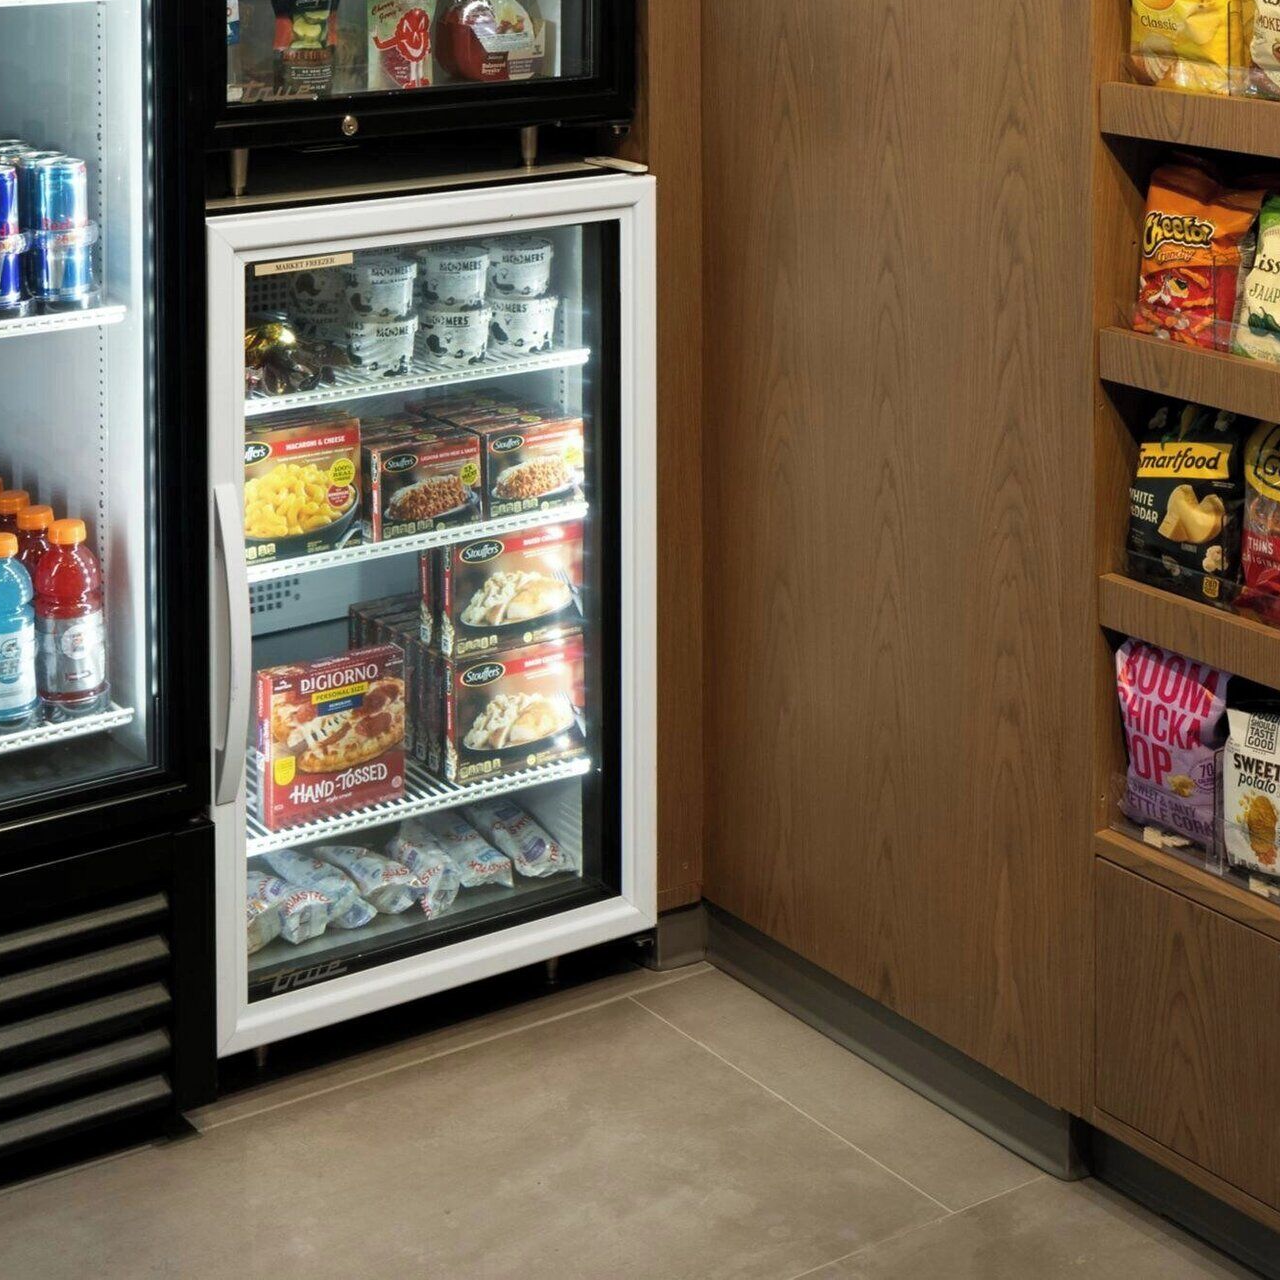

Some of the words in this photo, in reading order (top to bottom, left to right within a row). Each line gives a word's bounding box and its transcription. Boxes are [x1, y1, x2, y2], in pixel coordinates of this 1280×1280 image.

[1140, 15, 1178, 32] Classic
[275, 260, 305, 271] MARKET
[305, 257, 335, 269] FREEZER
[285, 438, 317, 451] MACARONI
[323, 435, 346, 445] CHEESE
[1137, 447, 1222, 473] Smartfood
[465, 544, 500, 560] Stouffer's
[1247, 537, 1274, 556] THINS
[465, 665, 501, 683] Stouffer's
[1118, 639, 1221, 718] BOOM
[315, 688, 350, 701] PERSONAL
[1250, 718, 1277, 732] SHOULD
[1249, 726, 1276, 742] TASTE
[1247, 736, 1276, 752] GOOD
[1237, 771, 1277, 795] potato
